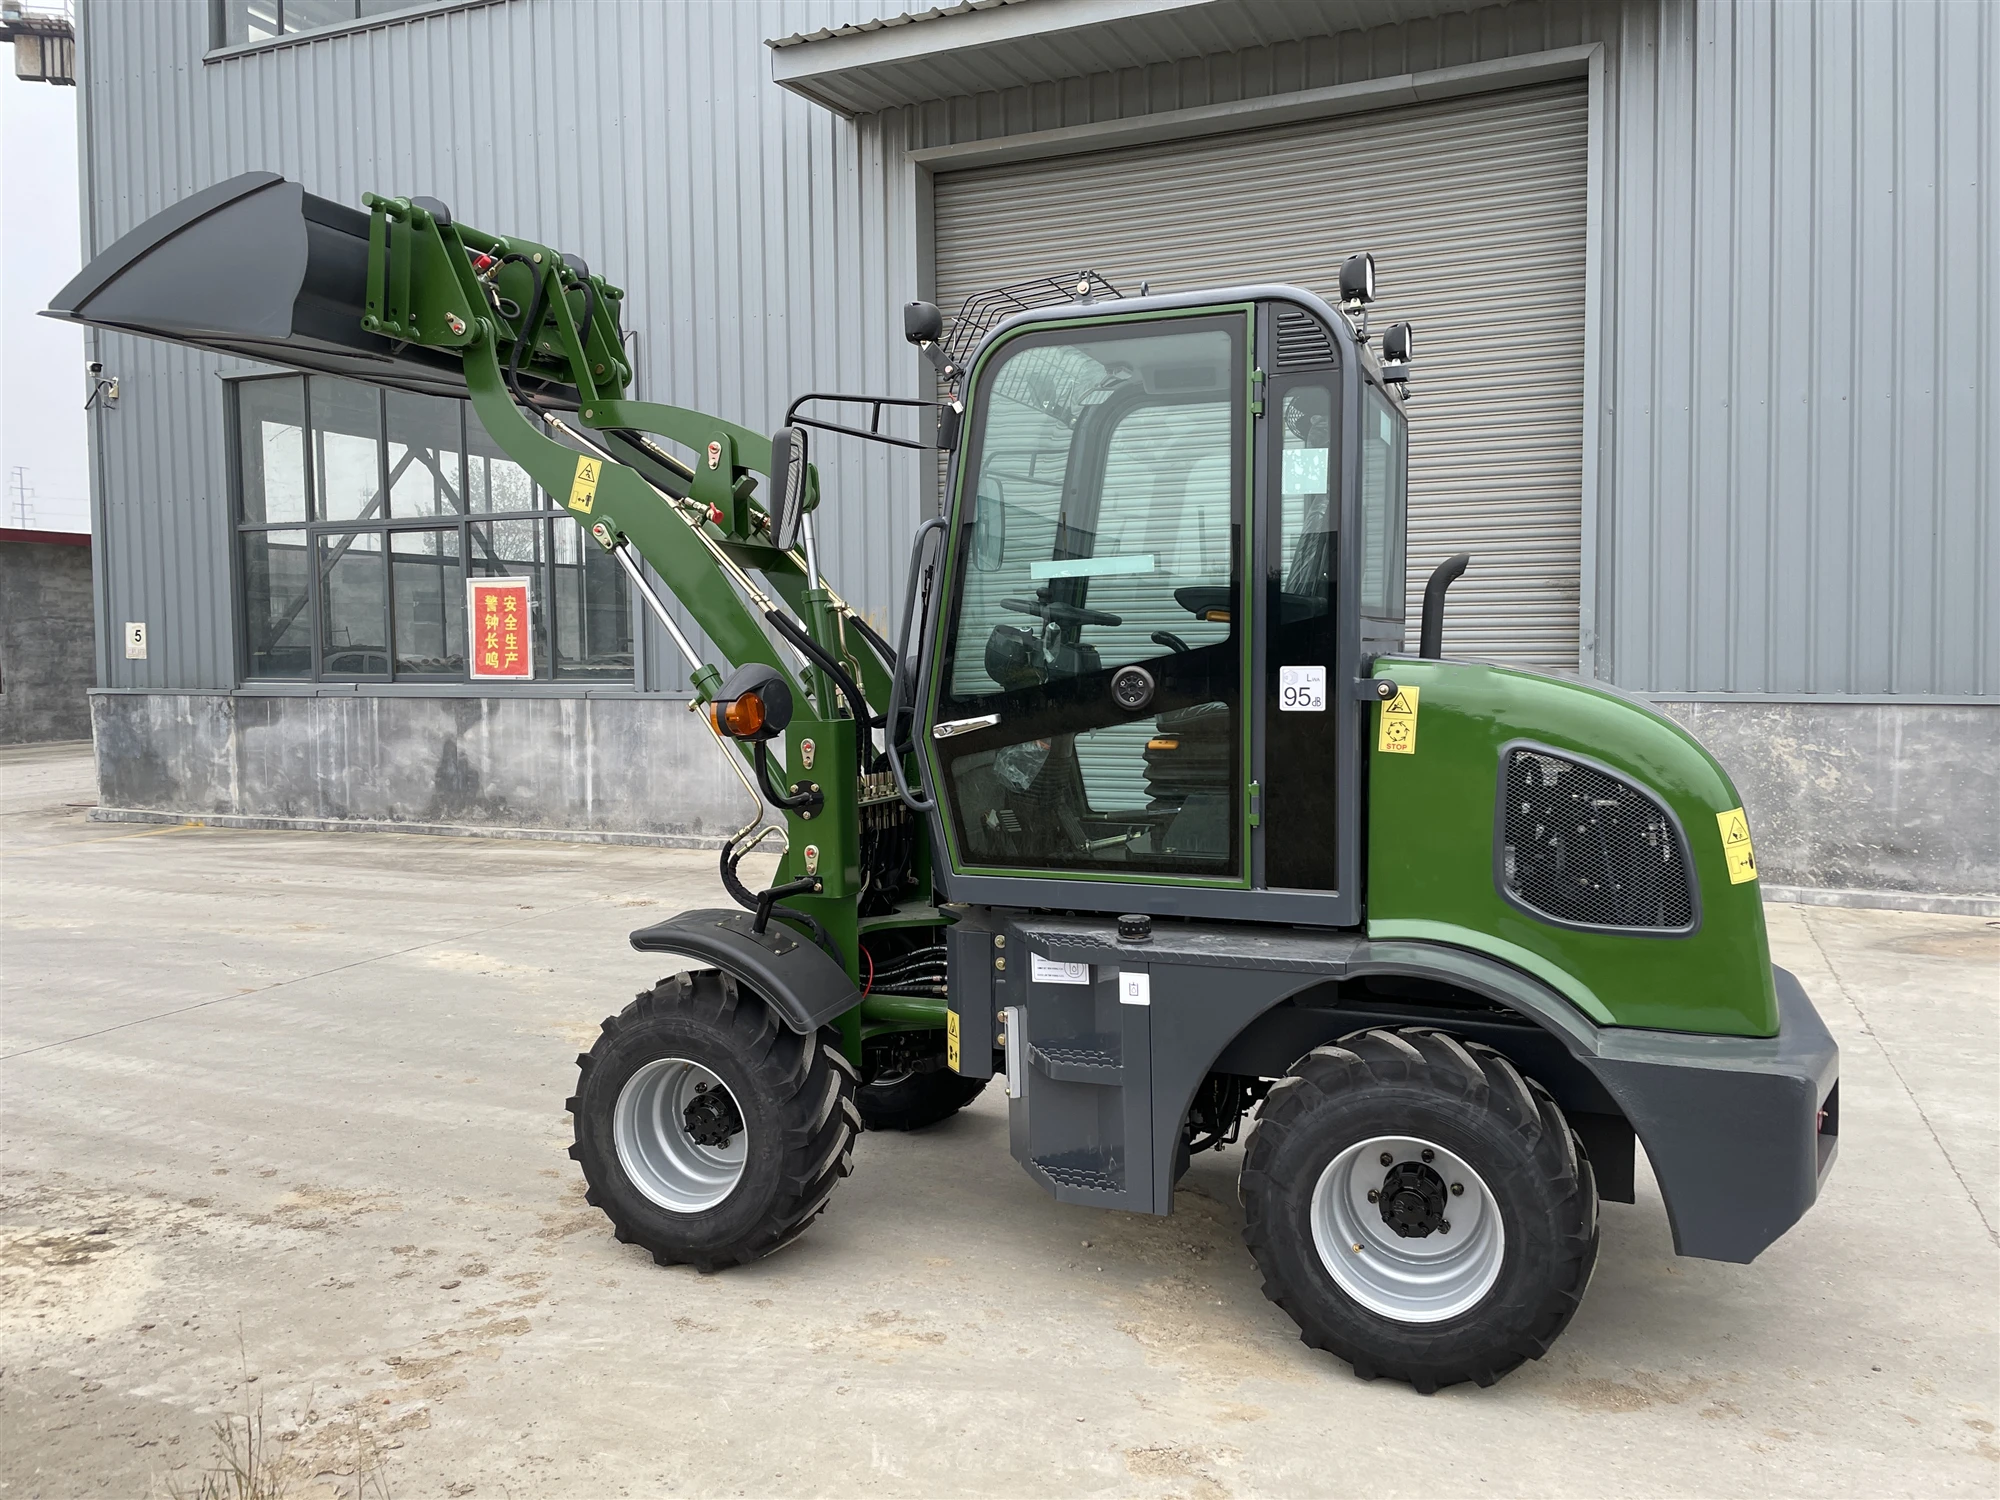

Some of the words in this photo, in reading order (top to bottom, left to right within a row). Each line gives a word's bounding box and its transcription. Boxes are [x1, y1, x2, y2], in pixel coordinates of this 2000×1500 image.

[135, 629, 142, 642] 5
[485, 595, 499, 668] 警钟长鸣
[504, 595, 518, 668] 安全生产
[1284, 686, 1311, 707] 95
[1311, 696, 1322, 707] dB
